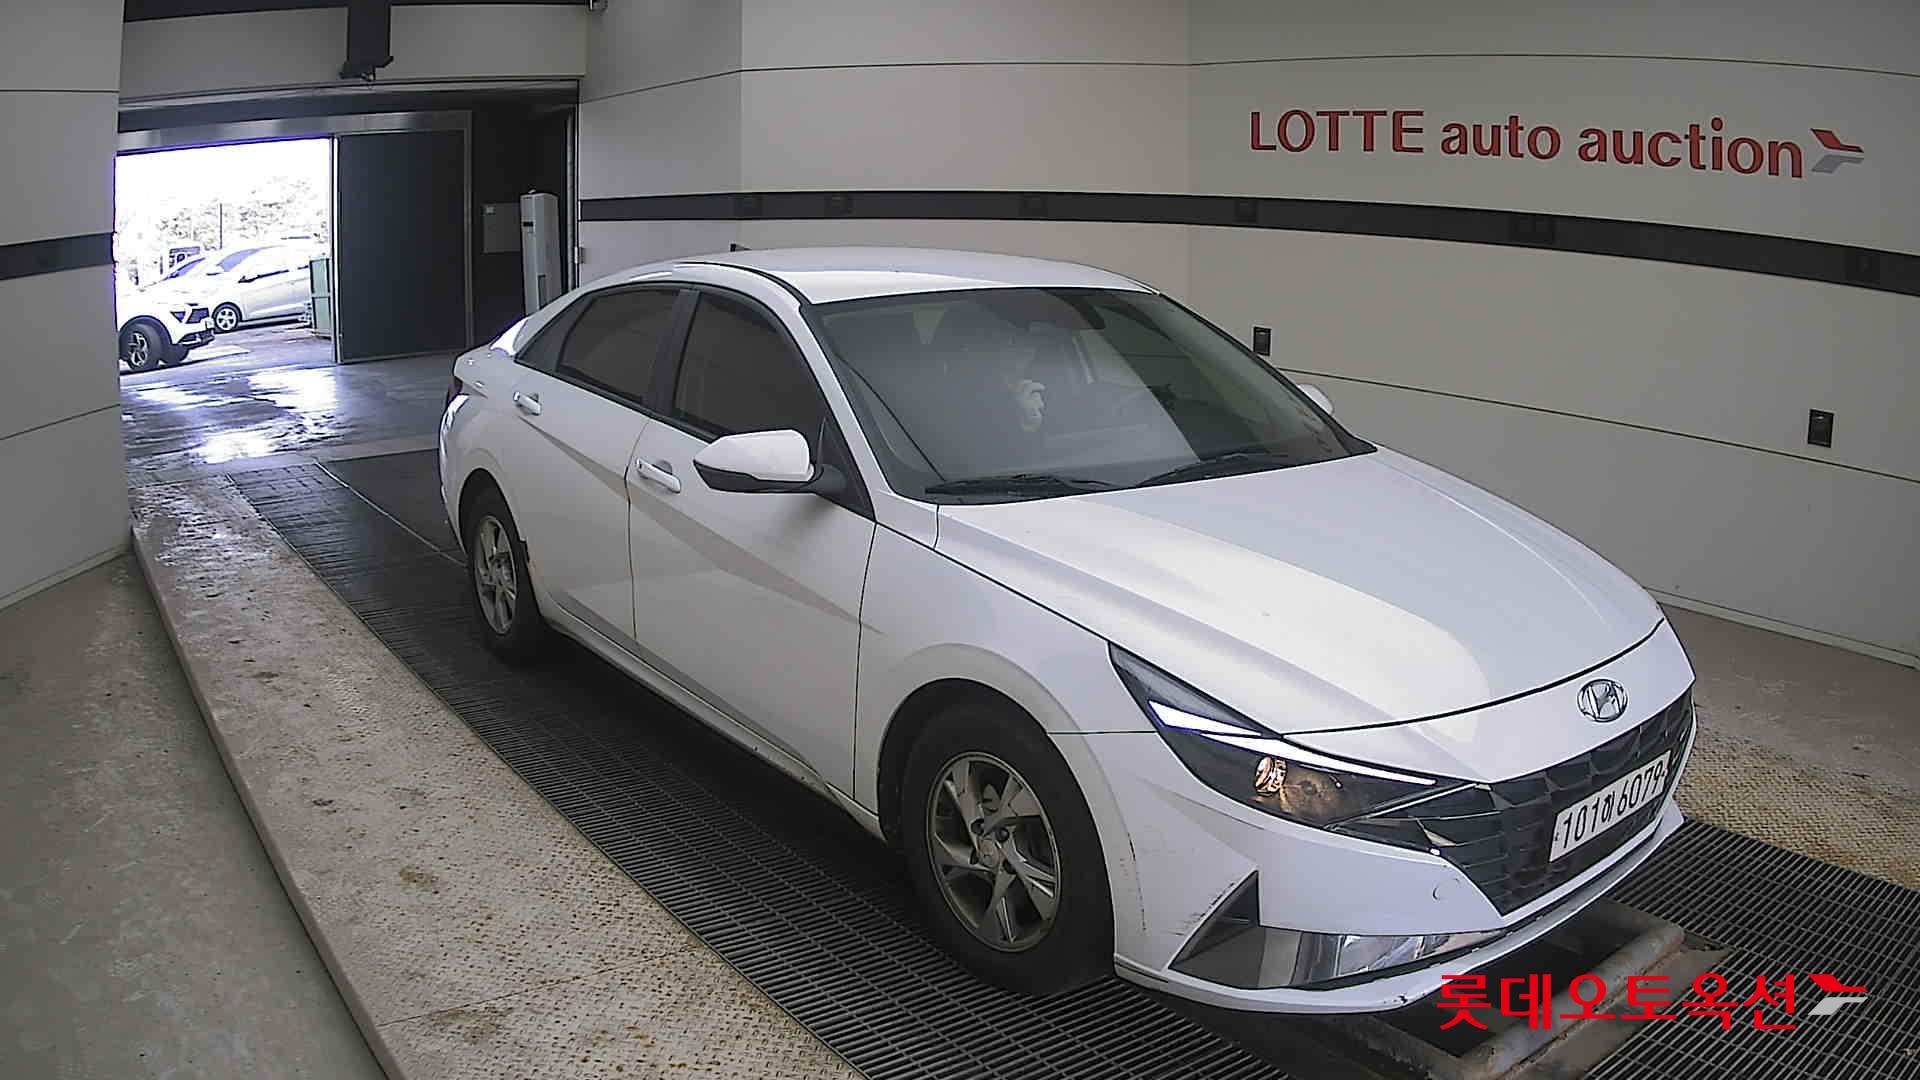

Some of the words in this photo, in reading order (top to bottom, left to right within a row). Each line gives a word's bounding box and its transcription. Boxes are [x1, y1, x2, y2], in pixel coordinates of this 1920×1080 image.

[1250, 109, 1424, 153] LOTTE
[1440, 114, 1562, 161] auto
[1577, 116, 1804, 179] auction
